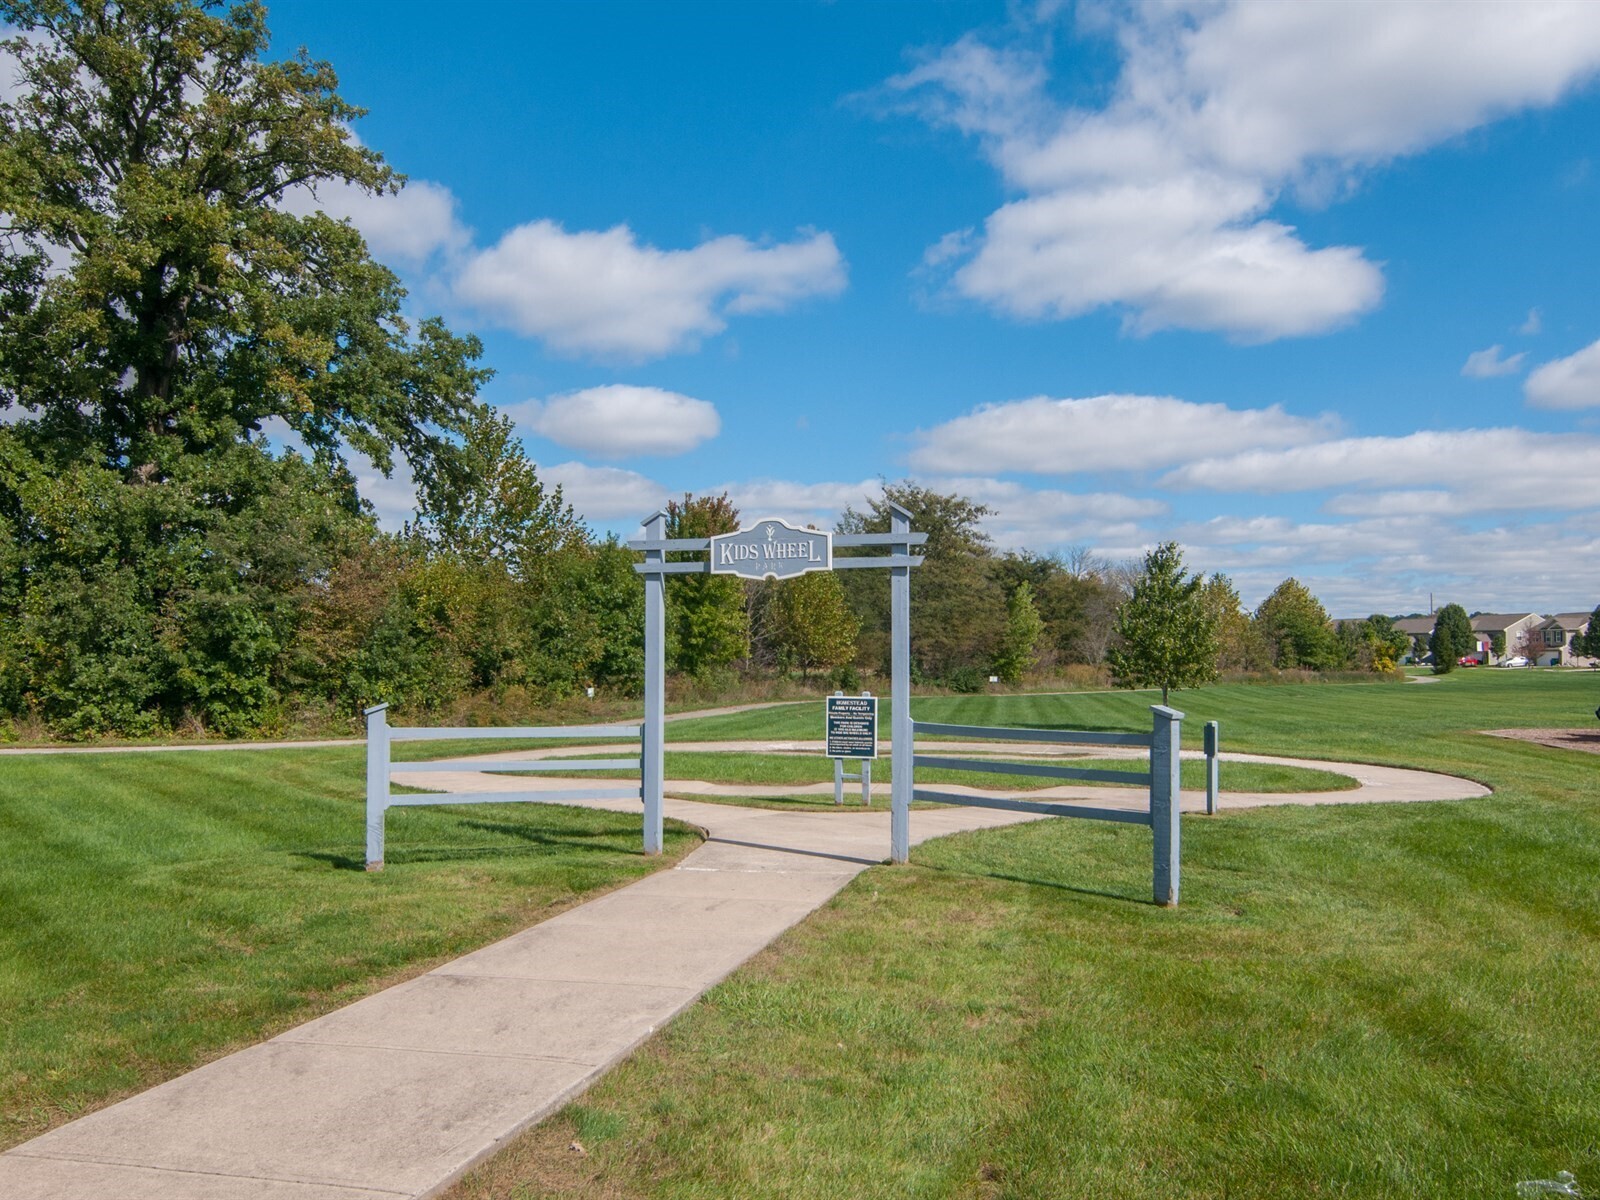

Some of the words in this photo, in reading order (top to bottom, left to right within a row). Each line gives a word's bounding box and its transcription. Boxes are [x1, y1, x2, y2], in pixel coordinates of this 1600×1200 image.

[720, 543, 759, 565] KIDS
[761, 540, 822, 562] WHEEL
[755, 561, 784, 571] PARK
